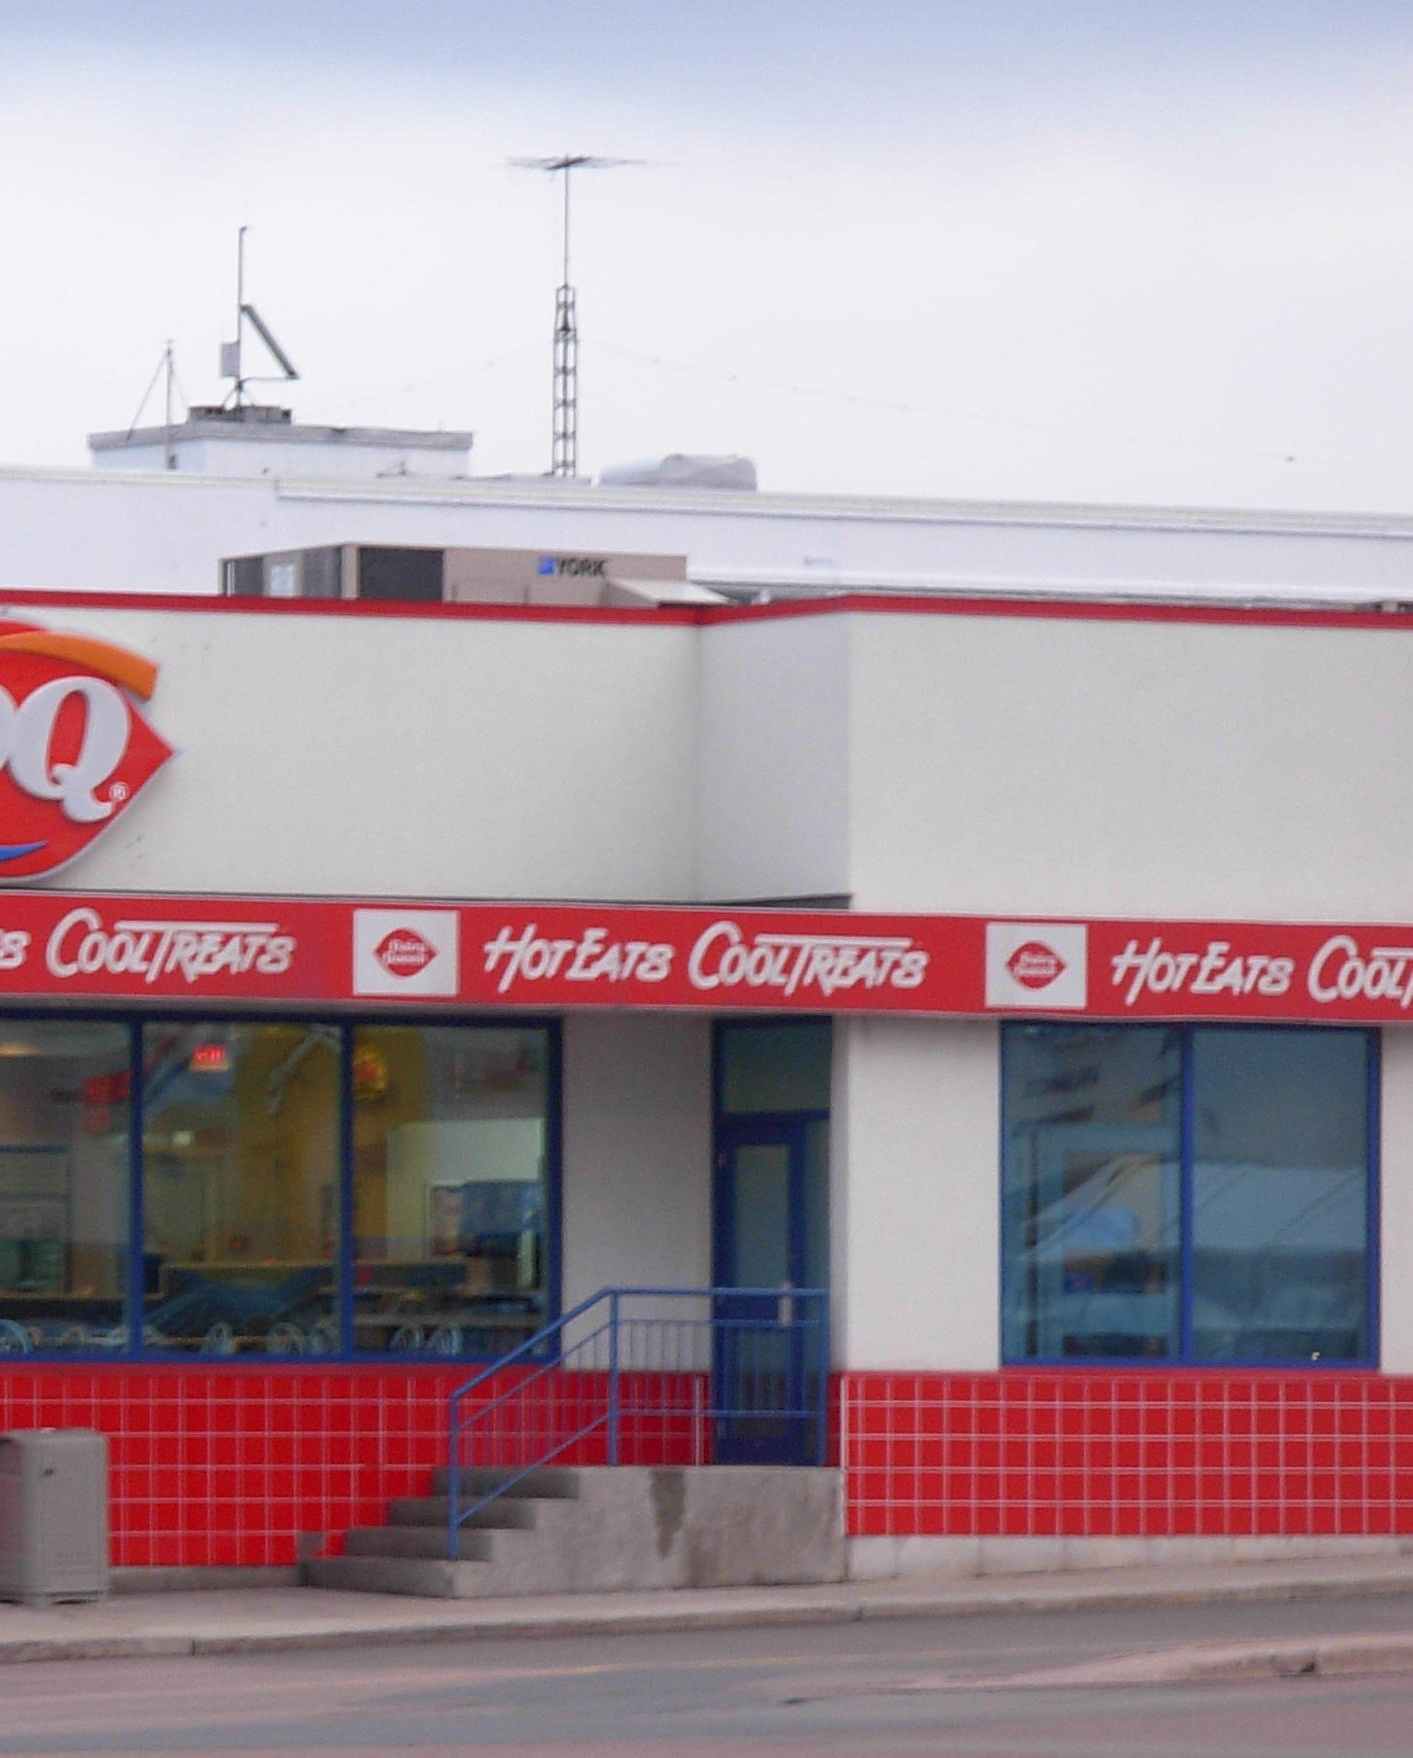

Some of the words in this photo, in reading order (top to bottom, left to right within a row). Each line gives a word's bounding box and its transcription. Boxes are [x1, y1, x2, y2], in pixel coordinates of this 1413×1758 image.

[556, 557, 607, 576] YORK
[1111, 937, 1199, 1007] HOT
[1190, 941, 1295, 996] EATS
[1307, 934, 1409, 1003] COOL
